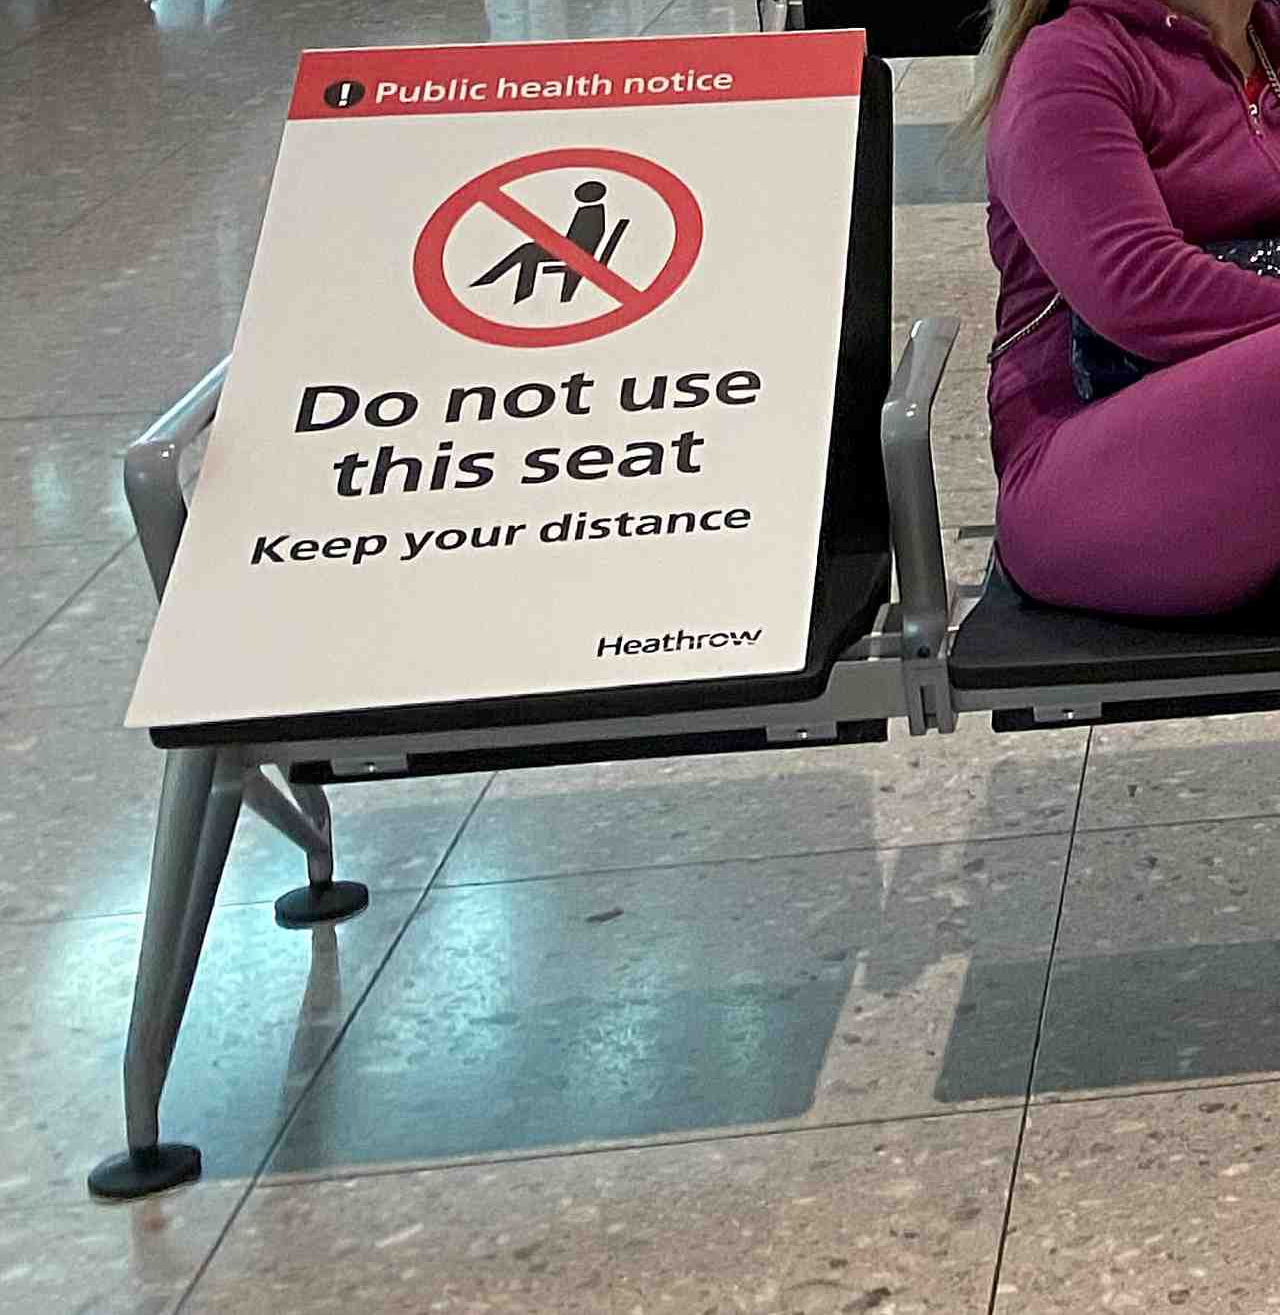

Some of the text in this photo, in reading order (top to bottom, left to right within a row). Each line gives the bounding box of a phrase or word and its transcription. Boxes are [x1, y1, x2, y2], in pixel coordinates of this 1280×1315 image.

[375, 69, 733, 104] Public health notice
[294, 370, 761, 434] Do not use
[333, 430, 705, 498] this seat
[250, 508, 752, 566] Keep your distance
[596, 629, 763, 658] Heathrow
